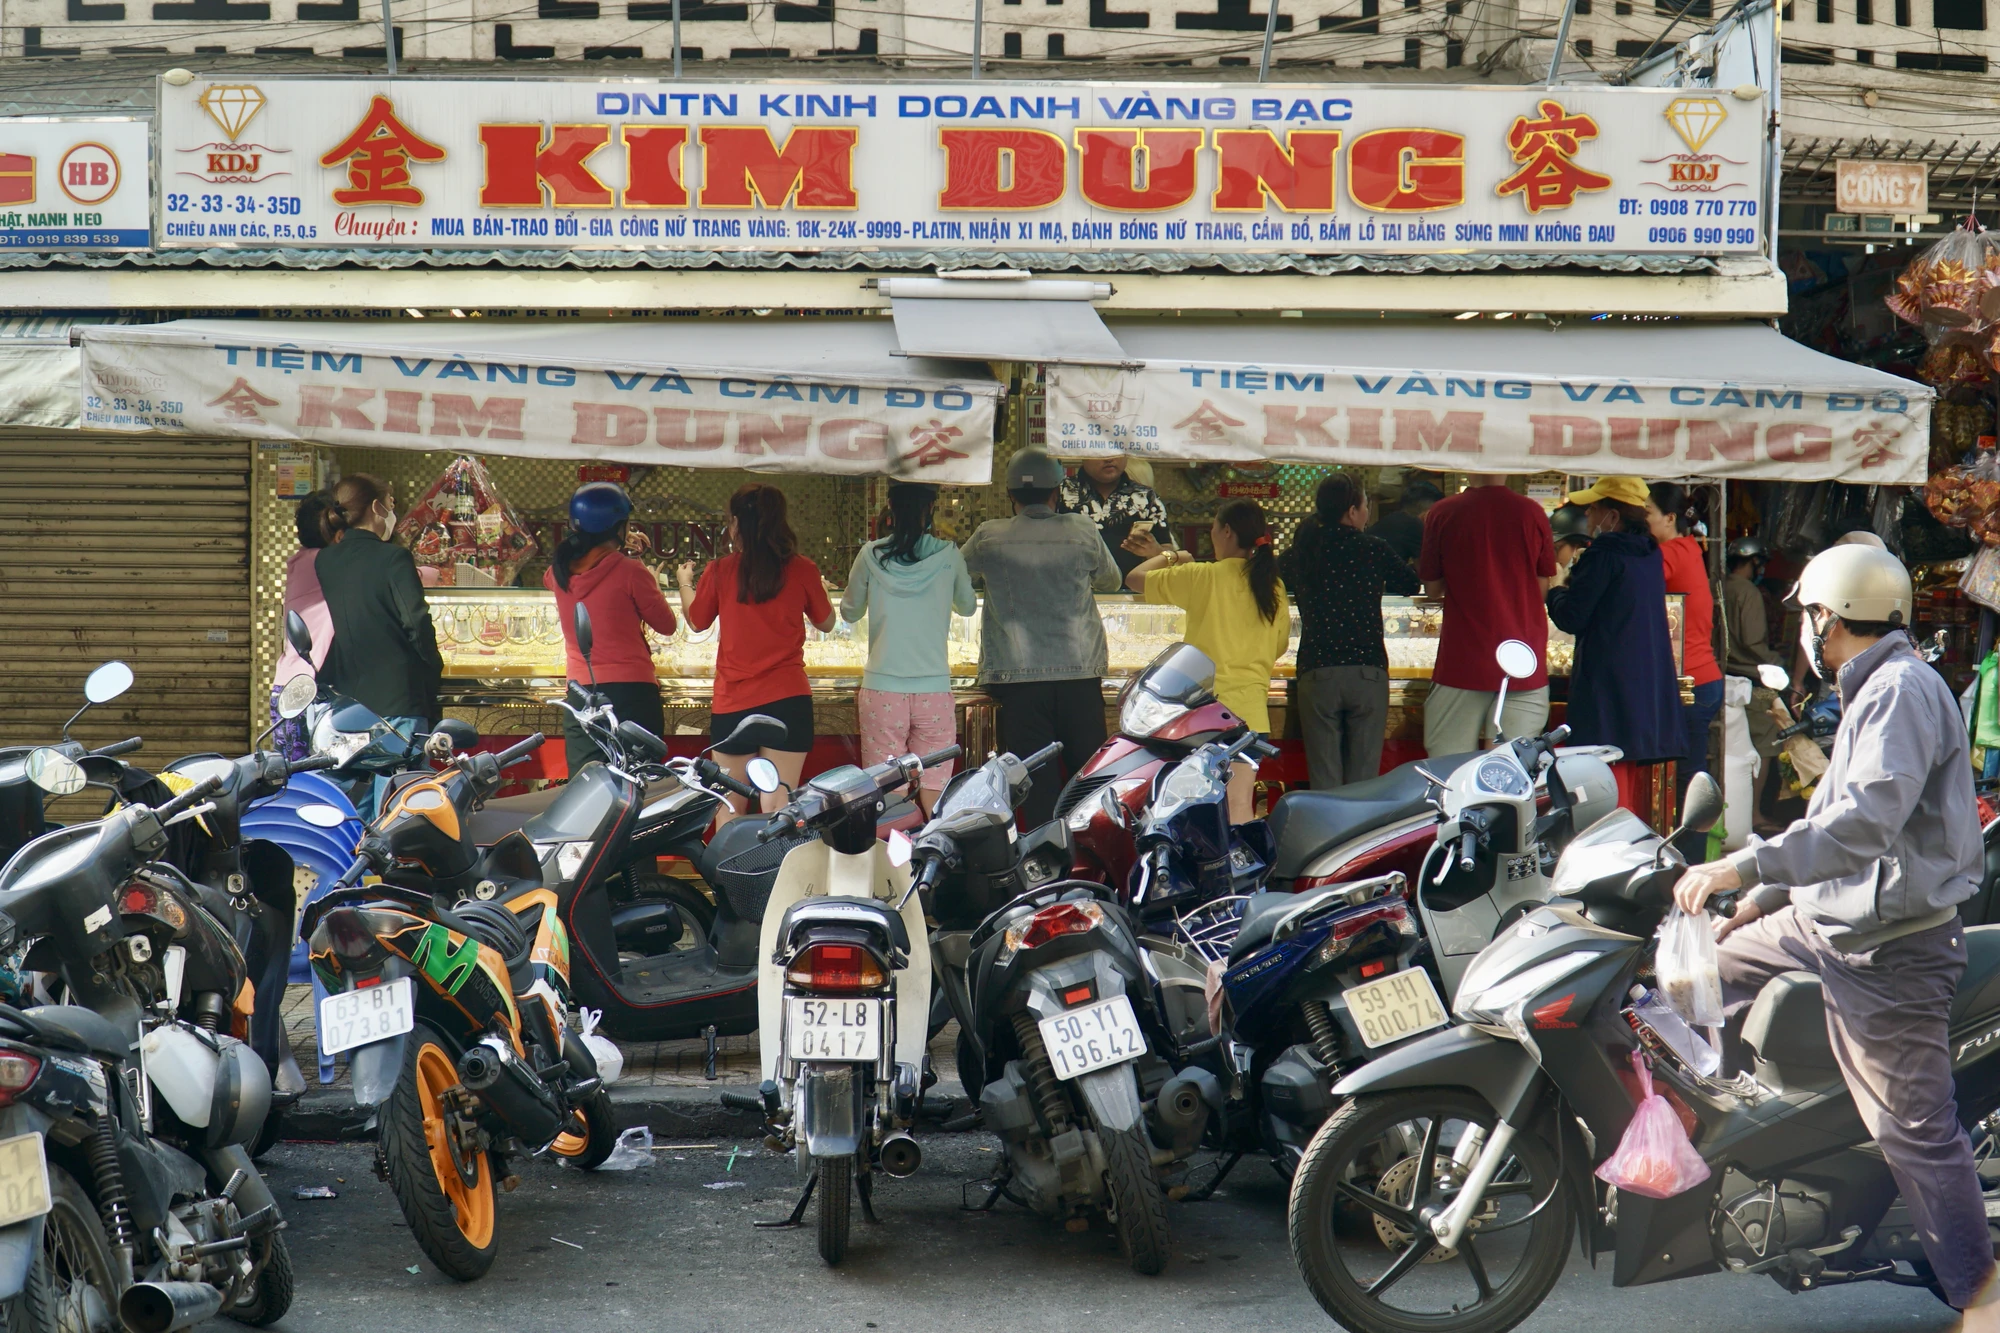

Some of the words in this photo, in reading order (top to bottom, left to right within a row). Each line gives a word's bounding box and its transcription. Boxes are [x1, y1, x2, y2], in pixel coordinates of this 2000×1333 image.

[596, 92, 738, 116] DNTN
[759, 94, 877, 118] KINH
[899, 95, 1080, 119] DOANH
[1098, 90, 1236, 121] VÀNG
[1251, 98, 1353, 124] BẠC
[207, 153, 262, 174] KDJ
[318, 94, 448, 208] 金
[478, 121, 859, 210] KIM
[937, 126, 1465, 213] DUNG
[1495, 99, 1612, 215] 容
[68, 162, 109, 186] HB
[1669, 162, 1719, 183] KDJ
[1908, 177, 1922, 205] 7
[27, 212, 67, 226] NANH
[73, 212, 103, 226] HEO
[1619, 199, 1642, 216] ĐT:
[1650, 199, 1688, 216] 0908
[1695, 200, 1724, 216] 770
[1728, 200, 1757, 216] 770
[27, 234, 60, 244] 0919
[64, 234, 88, 244] 839
[93, 234, 120, 244] 539
[166, 220, 205, 237] CHIÊU
[209, 223, 237, 237] ANH
[240, 220, 270, 239] CÁC,
[298, 224, 317, 239] Q.5
[431, 218, 465, 236] MUA
[620, 214, 659, 237] CÔNG
[665, 214, 687, 237] NỮ
[693, 219, 740, 238] TRANG
[748, 216, 790, 239] VÀNG:
[969, 217, 1010, 243] NHẬN
[1018, 222, 1032, 240] XI
[1039, 222, 1067, 244] MẠ,
[1072, 218, 1112, 240] ĐÁNH
[1120, 217, 1158, 241] BÓNG
[1166, 219, 1187, 240] NỮ
[1195, 222, 1247, 243] TRANG,
[1320, 215, 1351, 241] BẤM
[1359, 216, 1375, 241] LỖ
[1382, 223, 1401, 241] TAI
[1408, 217, 1445, 241] BẰNG
[1455, 220, 1492, 242] SÚNG
[1499, 224, 1528, 242] MINI
[1535, 220, 1581, 242] KHÔNG
[1588, 224, 1615, 242] ĐAU
[1649, 227, 1687, 244] 0906
[1694, 228, 1722, 244] 990
[1726, 228, 1755, 244] 990
[215, 342, 363, 374] TIỆM
[390, 353, 576, 387] VÀNG
[603, 366, 693, 395] VÀ
[1179, 364, 1325, 396] TIỆM
[1353, 370, 1532, 400] VÀNG
[1559, 377, 1644, 404] VÀ
[206, 376, 281, 427] 金
[1087, 399, 1122, 413] KDJ
[113, 414, 132, 424] ANH
[297, 384, 526, 441] KIM
[571, 401, 889, 460] DUNG
[1172, 399, 1245, 446] 金
[1262, 404, 1485, 453] KIM
[1528, 414, 1833, 463] DUNG
[903, 418, 970, 468] 容
[1089, 440, 1105, 449] ANH
[1845, 421, 1906, 469] 容
[335, 985, 394, 1020] 63-B1
[1357, 974, 1420, 1014] 59-H1
[803, 1001, 867, 1027] 52-L8
[1054, 1004, 1118, 1043] 50-Y1
[1534, 1021, 1578, 1030] HONDA
[802, 1030, 866, 1056] 0417
[1056, 1028, 1139, 1073] 196.42
